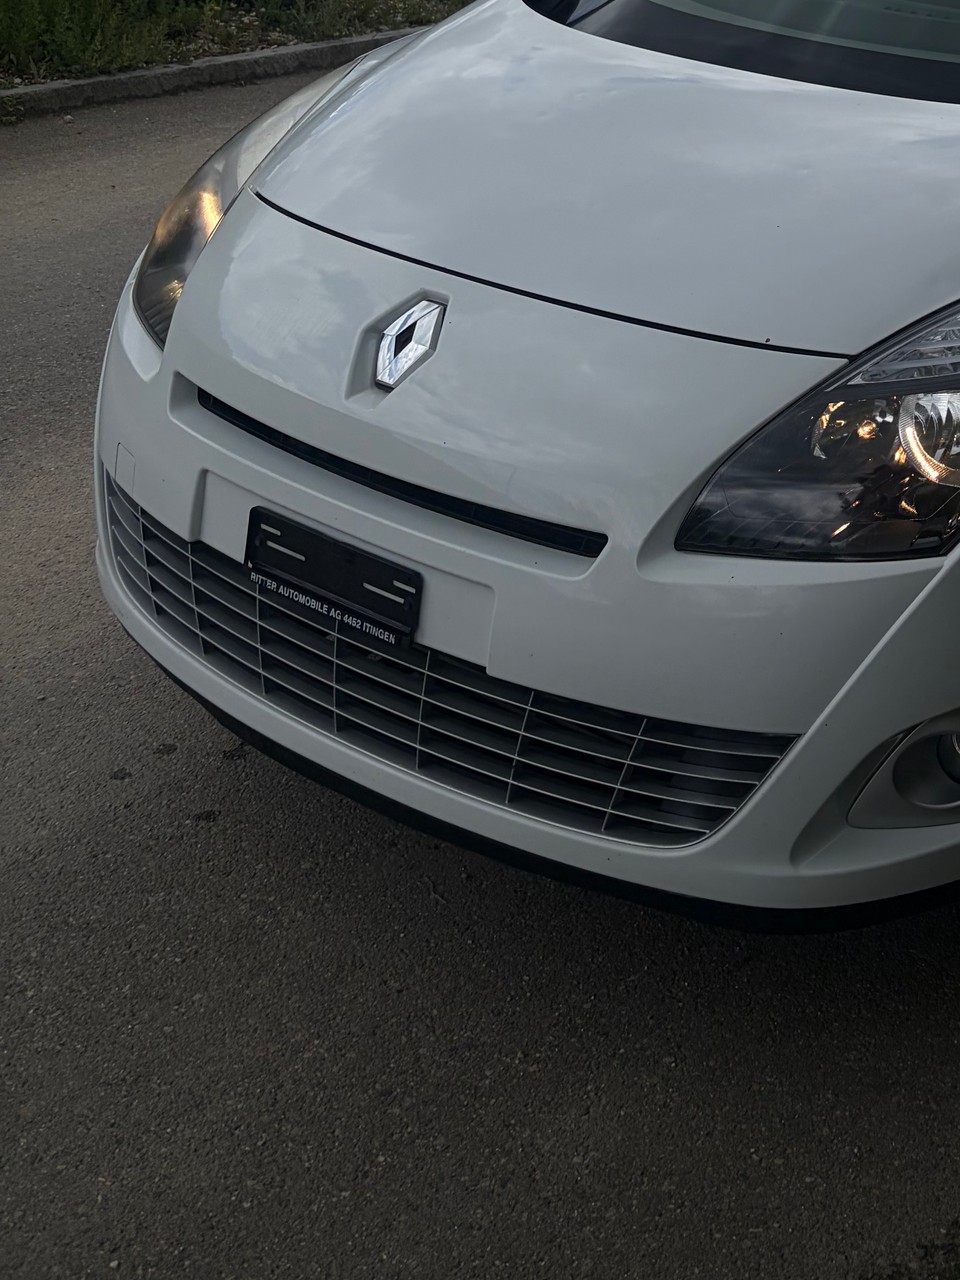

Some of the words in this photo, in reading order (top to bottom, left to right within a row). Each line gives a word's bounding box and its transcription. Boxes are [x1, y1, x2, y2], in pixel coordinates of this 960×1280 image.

[250, 572, 277, 591] RITTER
[278, 585, 328, 615] AUTOMOBILE
[330, 608, 342, 620] AG
[343, 614, 361, 629] 4452
[362, 622, 396, 644] ITINGEN
